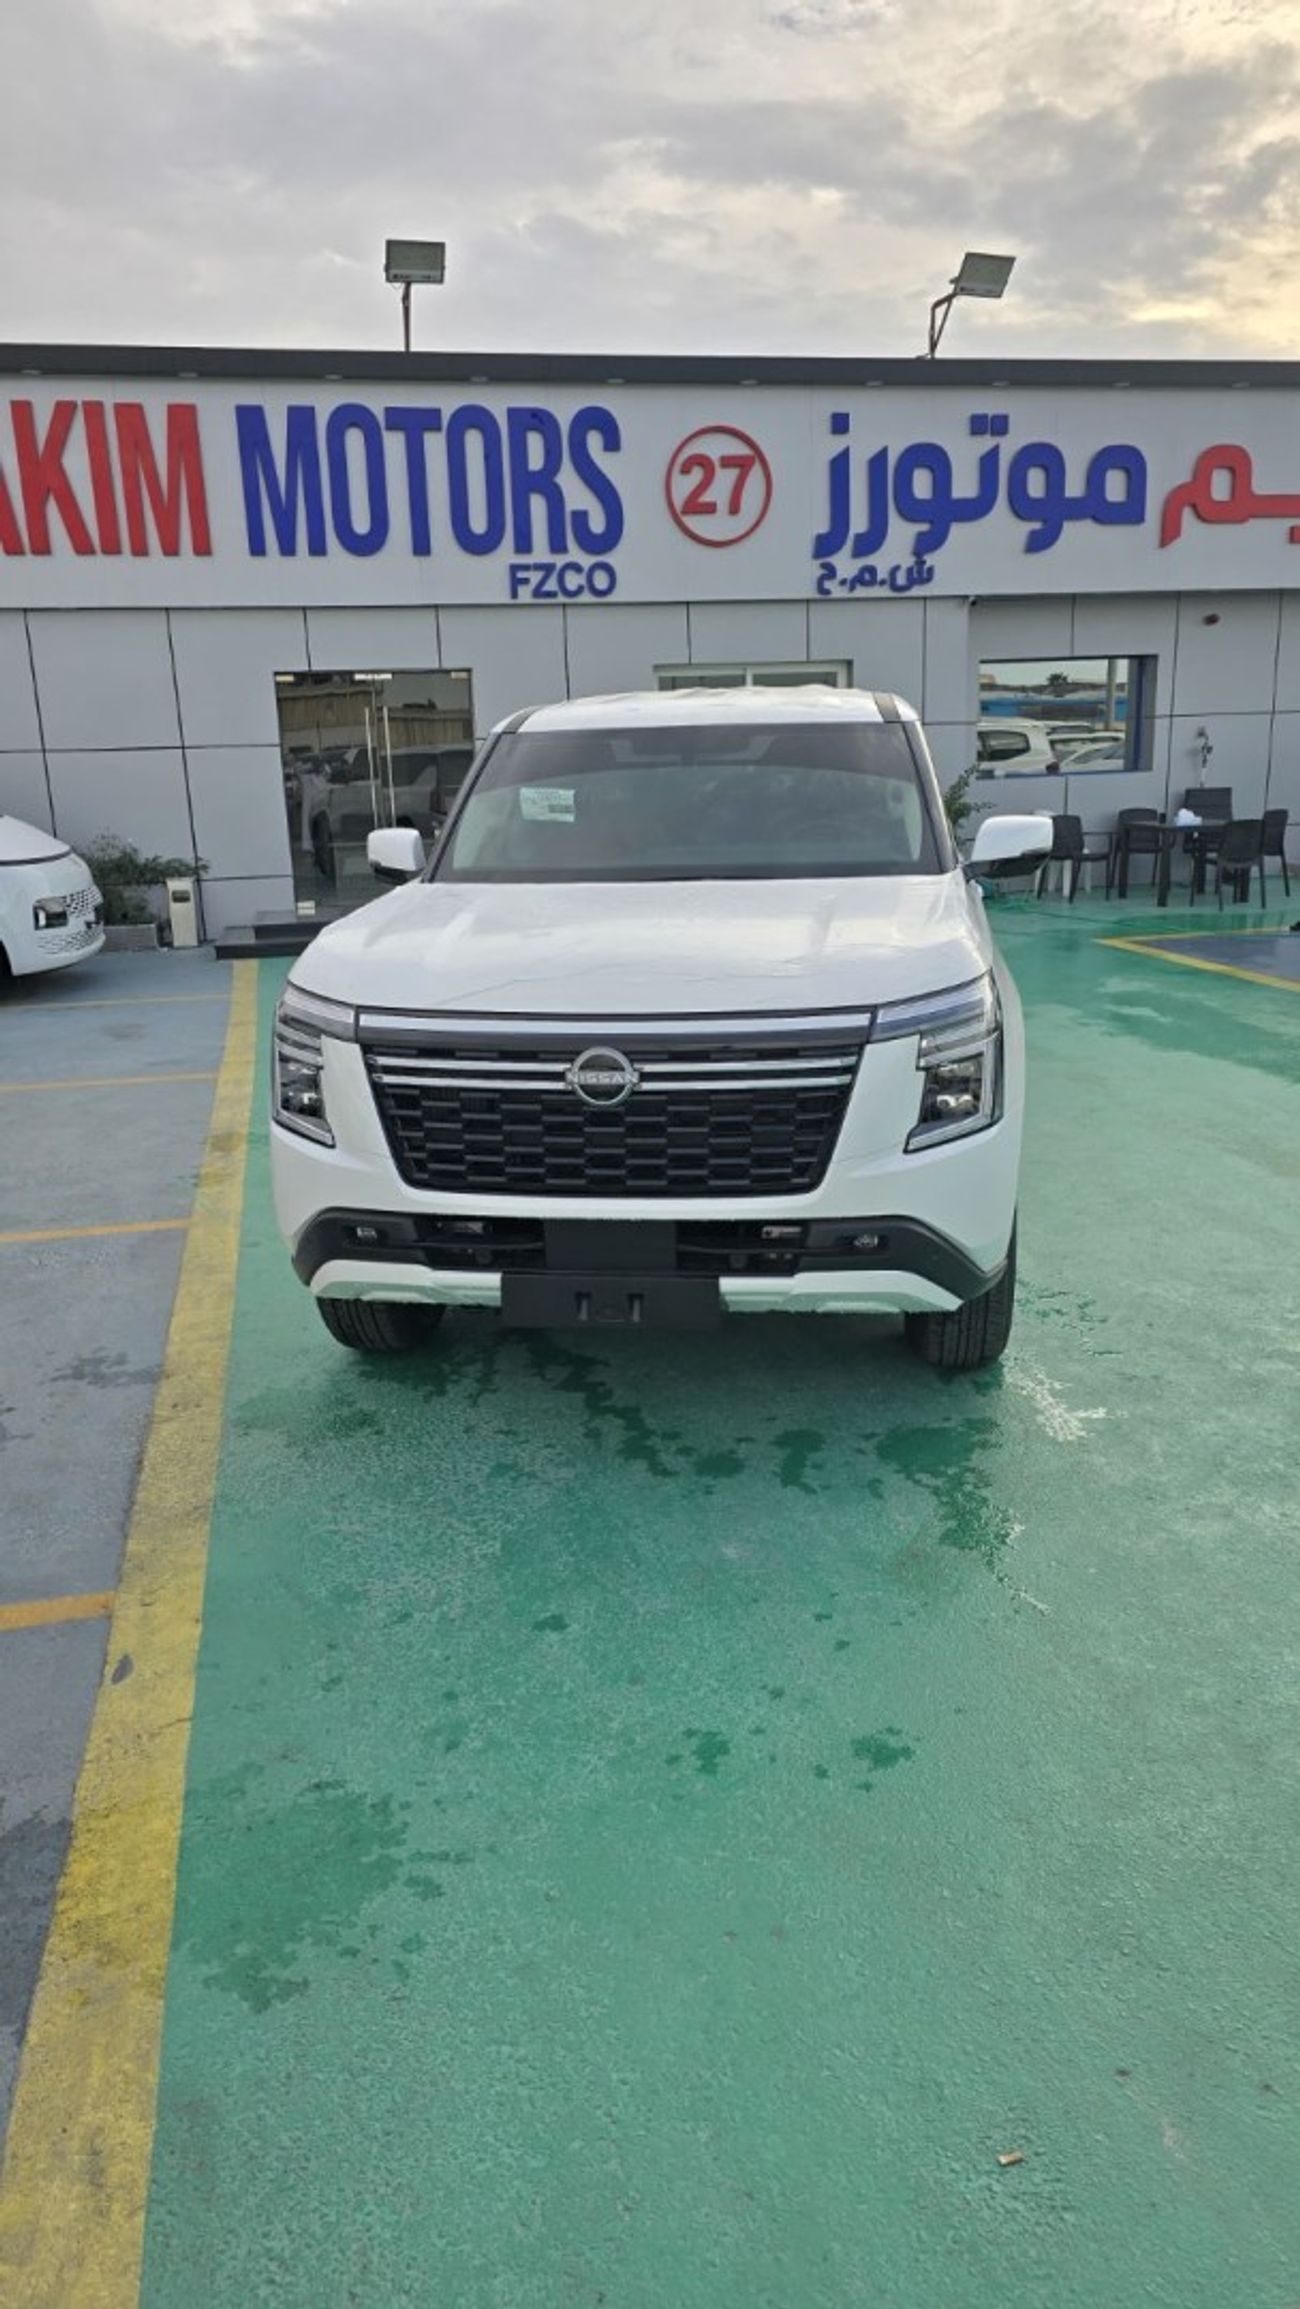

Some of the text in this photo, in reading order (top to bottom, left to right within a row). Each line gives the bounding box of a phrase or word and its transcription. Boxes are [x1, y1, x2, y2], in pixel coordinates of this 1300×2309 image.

[235, 403, 624, 557] MOTORS
[679, 454, 756, 516] 27
[813, 412, 1147, 558] موتورز
[509, 562, 617, 599] FZCO
[565, 1071, 639, 1085] NISSAN
